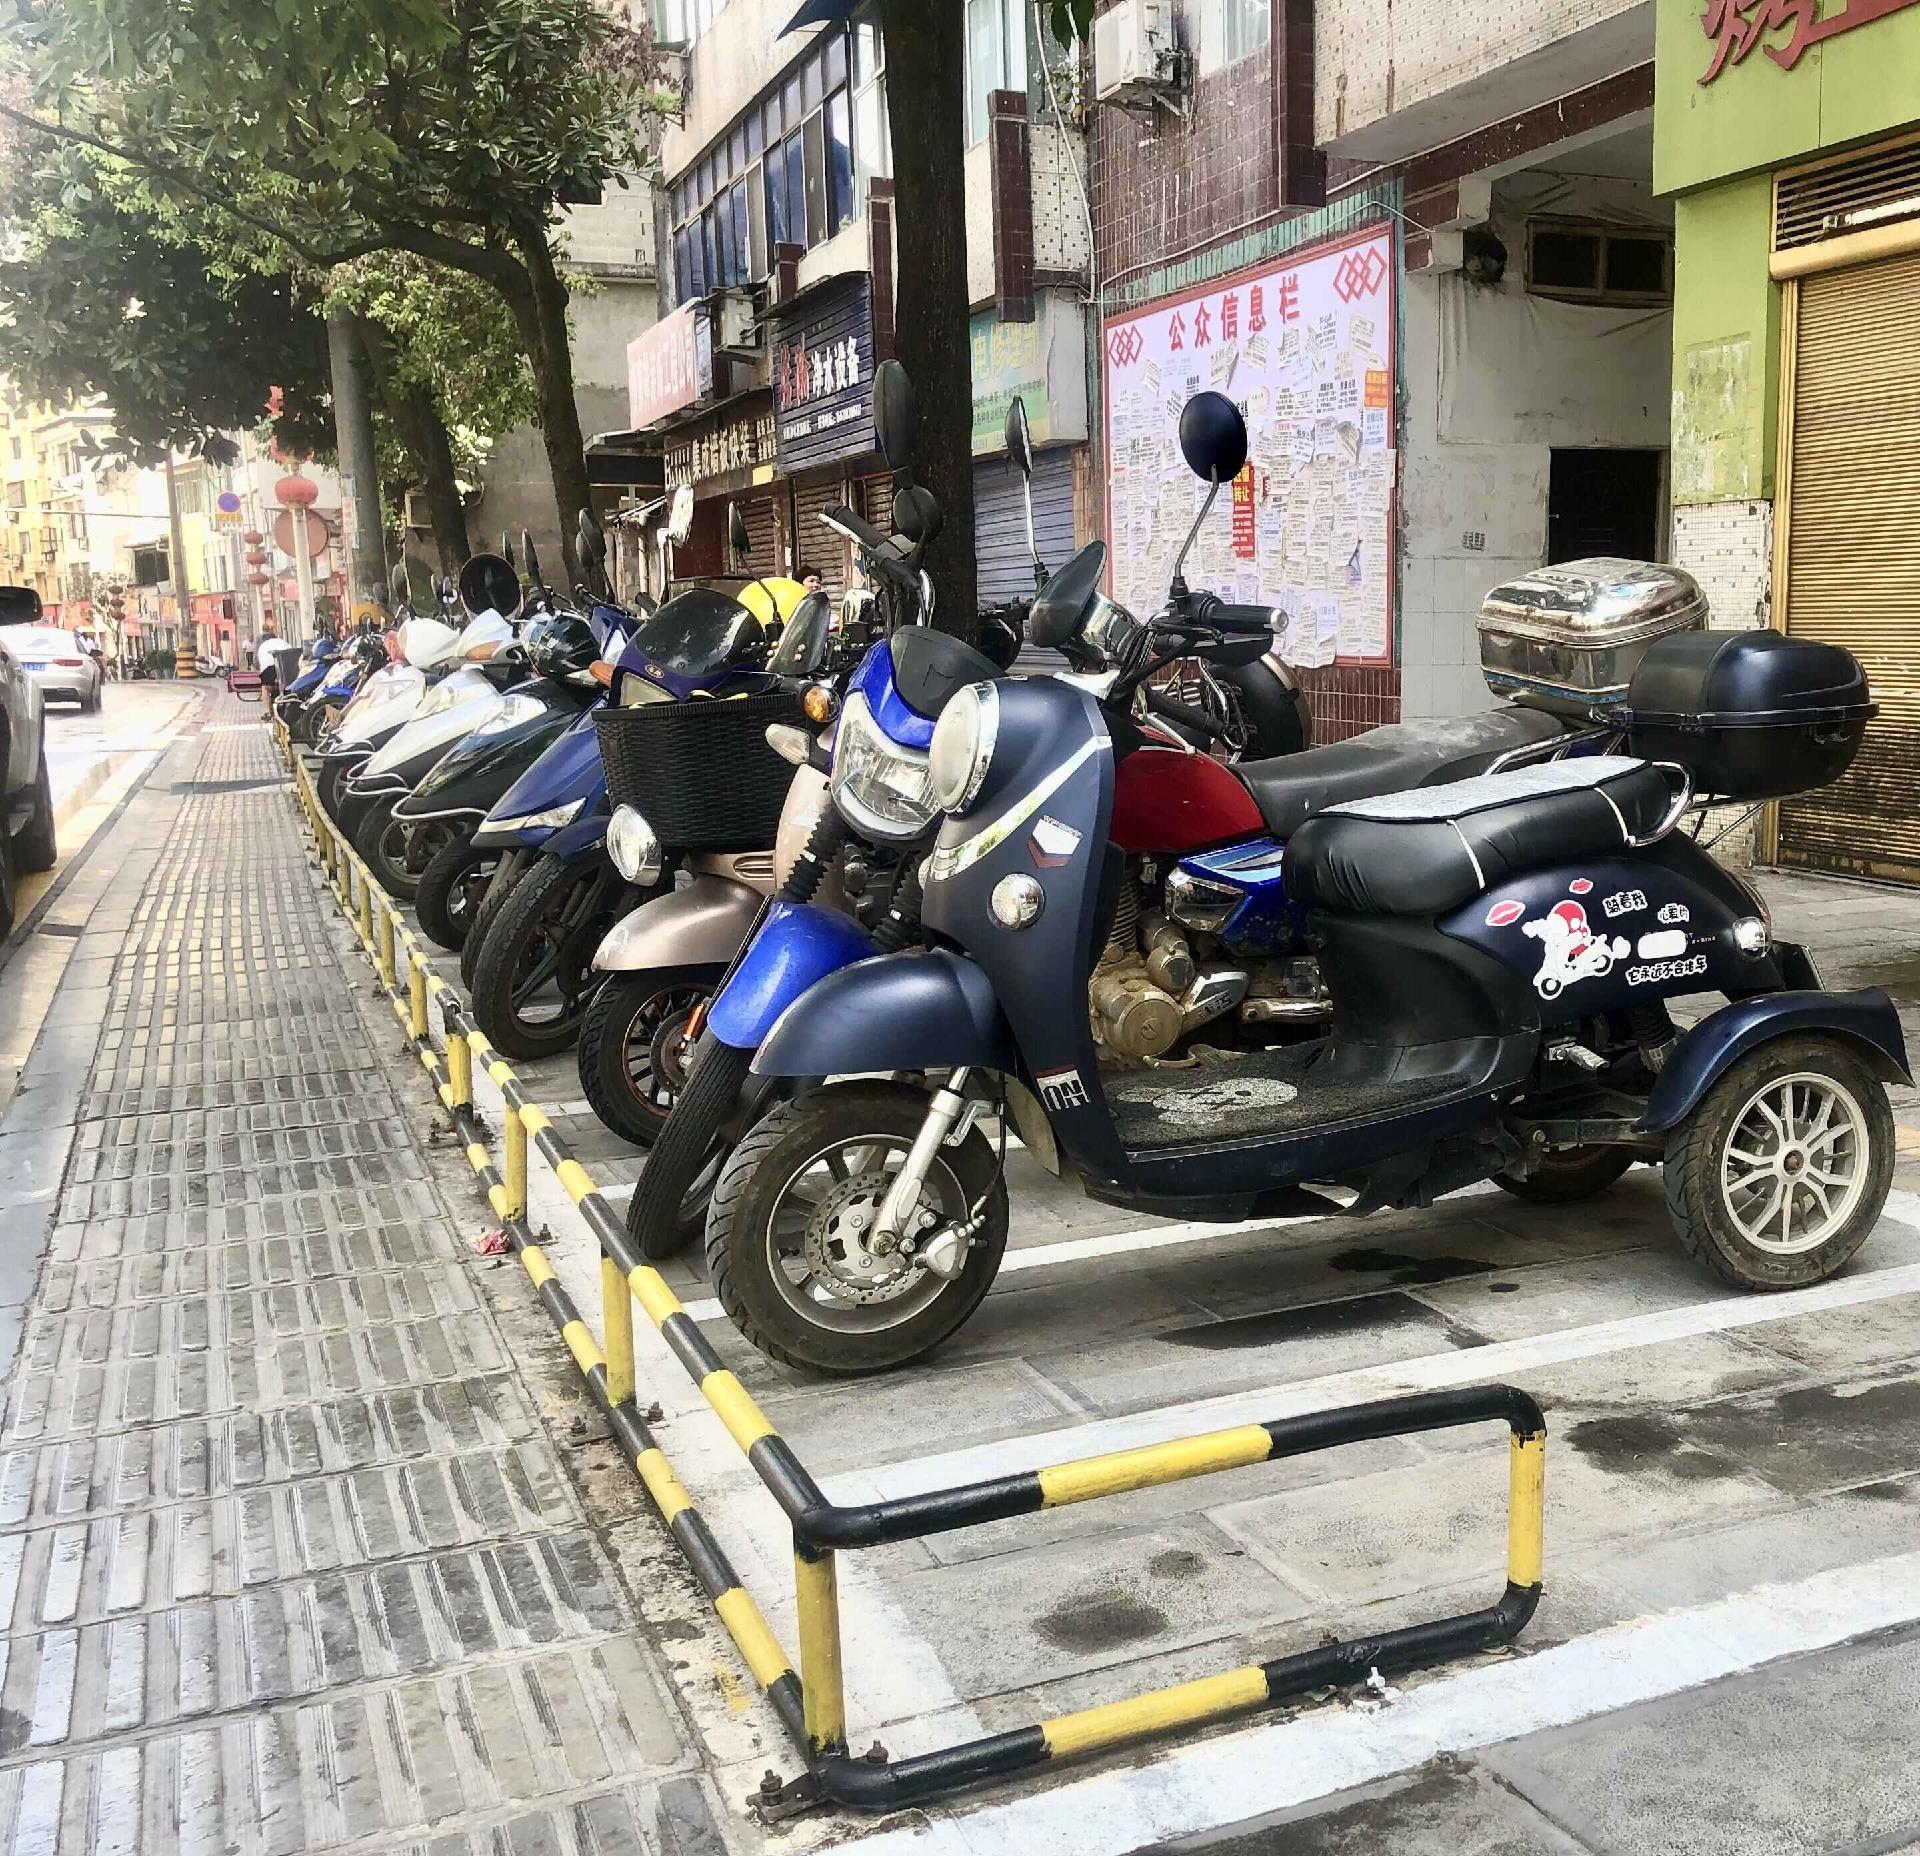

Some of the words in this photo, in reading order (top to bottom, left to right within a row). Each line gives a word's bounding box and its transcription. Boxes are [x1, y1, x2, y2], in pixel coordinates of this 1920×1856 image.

[1168, 272, 1301, 352] 公众信息栏
[1234, 485, 1250, 503] 转让
[1604, 890, 1647, 915] 骑着我
